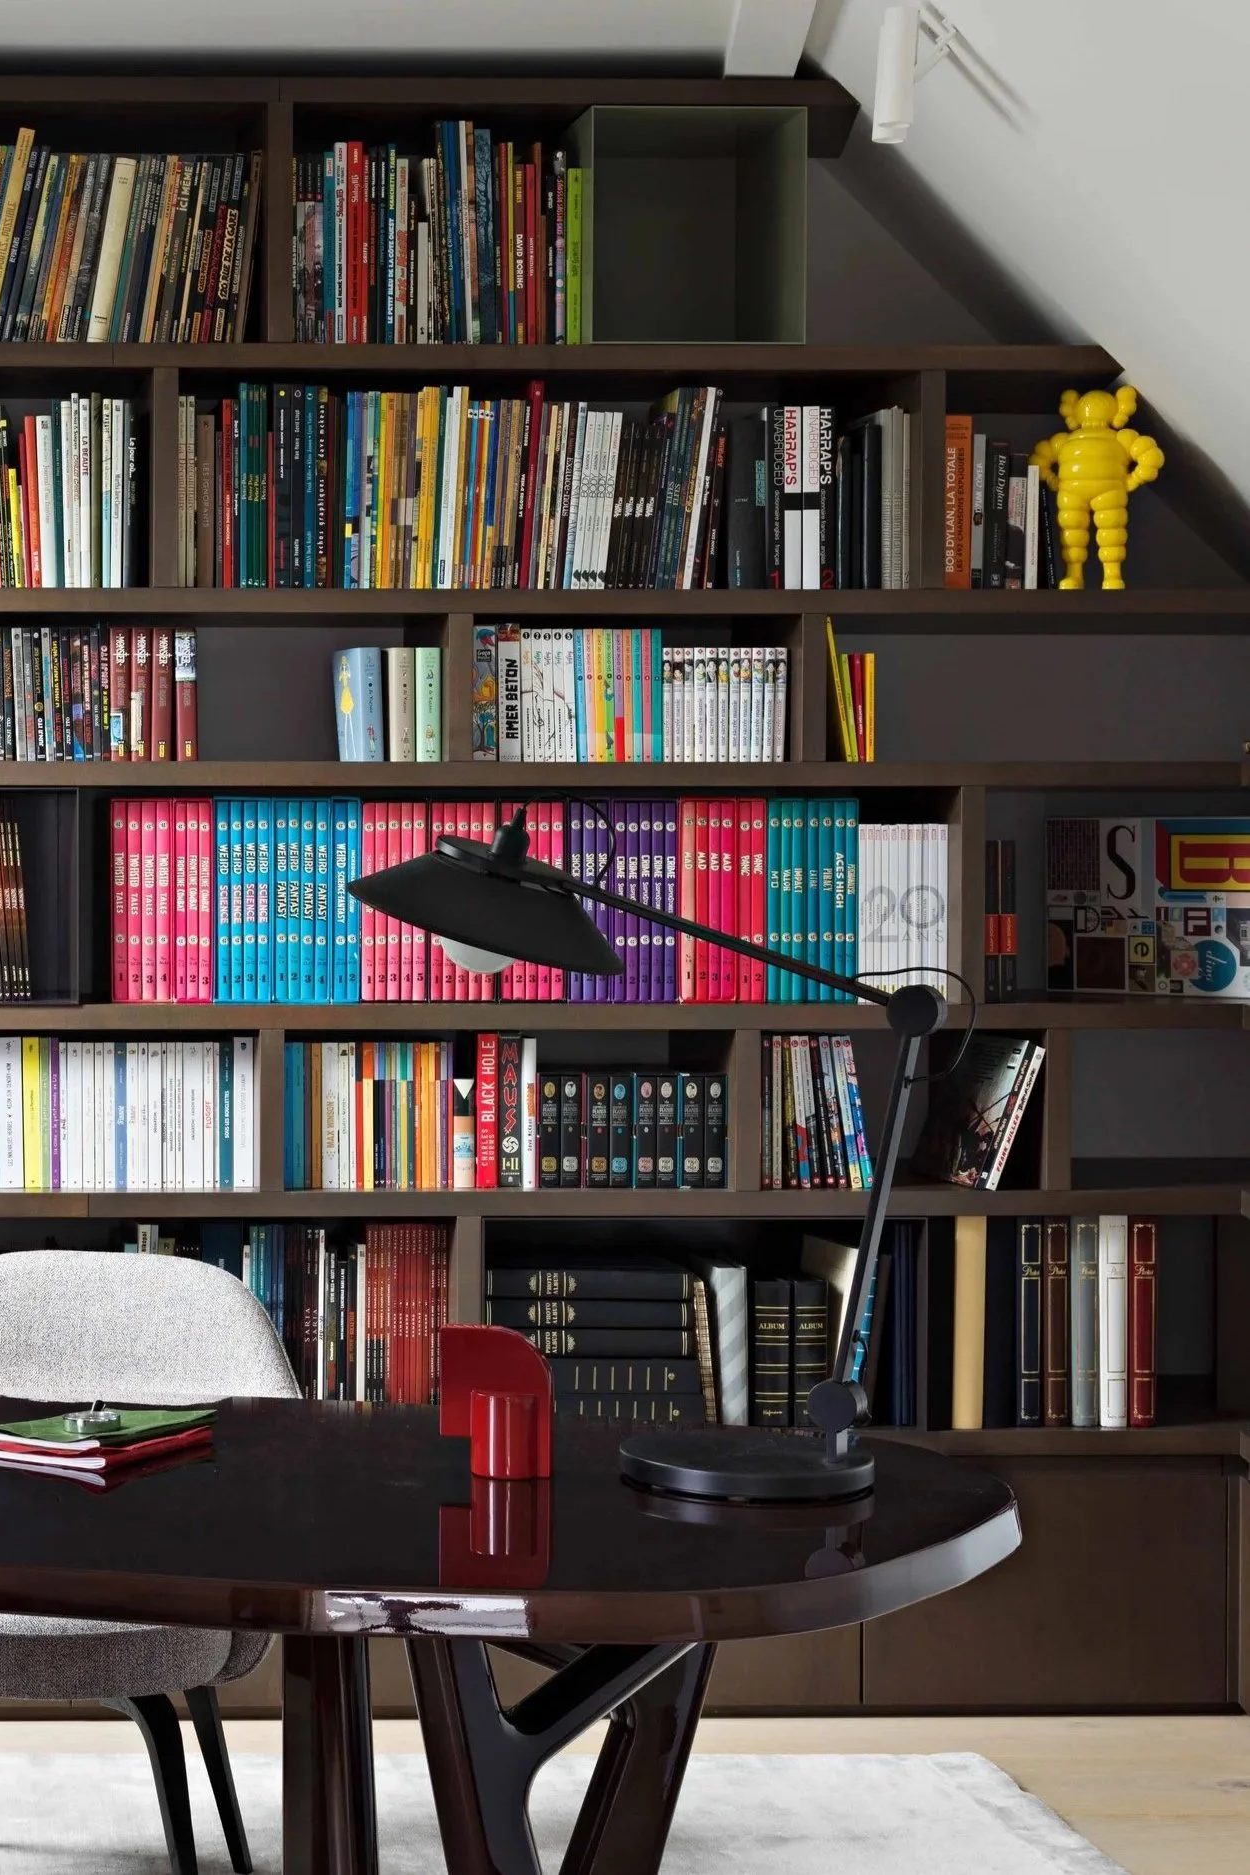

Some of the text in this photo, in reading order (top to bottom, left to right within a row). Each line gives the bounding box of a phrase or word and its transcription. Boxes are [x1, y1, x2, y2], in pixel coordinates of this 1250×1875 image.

[2, 201, 17, 237] POSSIBLE
[225, 209, 238, 237] GARE
[388, 218, 396, 245] OUEST
[221, 263, 232, 281] RUE
[388, 274, 395, 282] DE
[218, 280, 230, 299] 120
[60, 305, 70, 338] casterman
[71, 307, 83, 339] casterman
[317, 437, 325, 458] dave
[774, 410, 784, 485] UNABRIDGED
[786, 410, 796, 485] HARRAP'S
[808, 408, 818, 485] UNABRIDGED
[820, 408, 831, 485] HARRAP'S
[201, 462, 210, 527] LES IGNORANTS
[581, 473, 589, 498] BODY
[317, 479, 326, 526] graphiques
[945, 447, 957, 573] BOB DYLAN, LA TOTALE
[505, 658, 519, 739] AMER BETON
[571, 853, 581, 878] SHOCK
[616, 856, 626, 879] CRIME
[698, 852, 706, 870] MAD
[754, 853, 763, 875] PANIC
[259, 843, 268, 923] WEIRD SCIENCE
[277, 842, 286, 918] WEIRD FANTASY
[794, 867, 803, 894] IMPACT
[836, 852, 844, 908] ACES HIGH
[481, 1041, 495, 1122] BLACK HOLE
[326, 1100, 335, 1149] MAX WINSON
[481, 1129, 489, 1167] CHARLES
[759, 1322, 786, 1331] ALBUM
[798, 1322, 824, 1331] ALBUM
